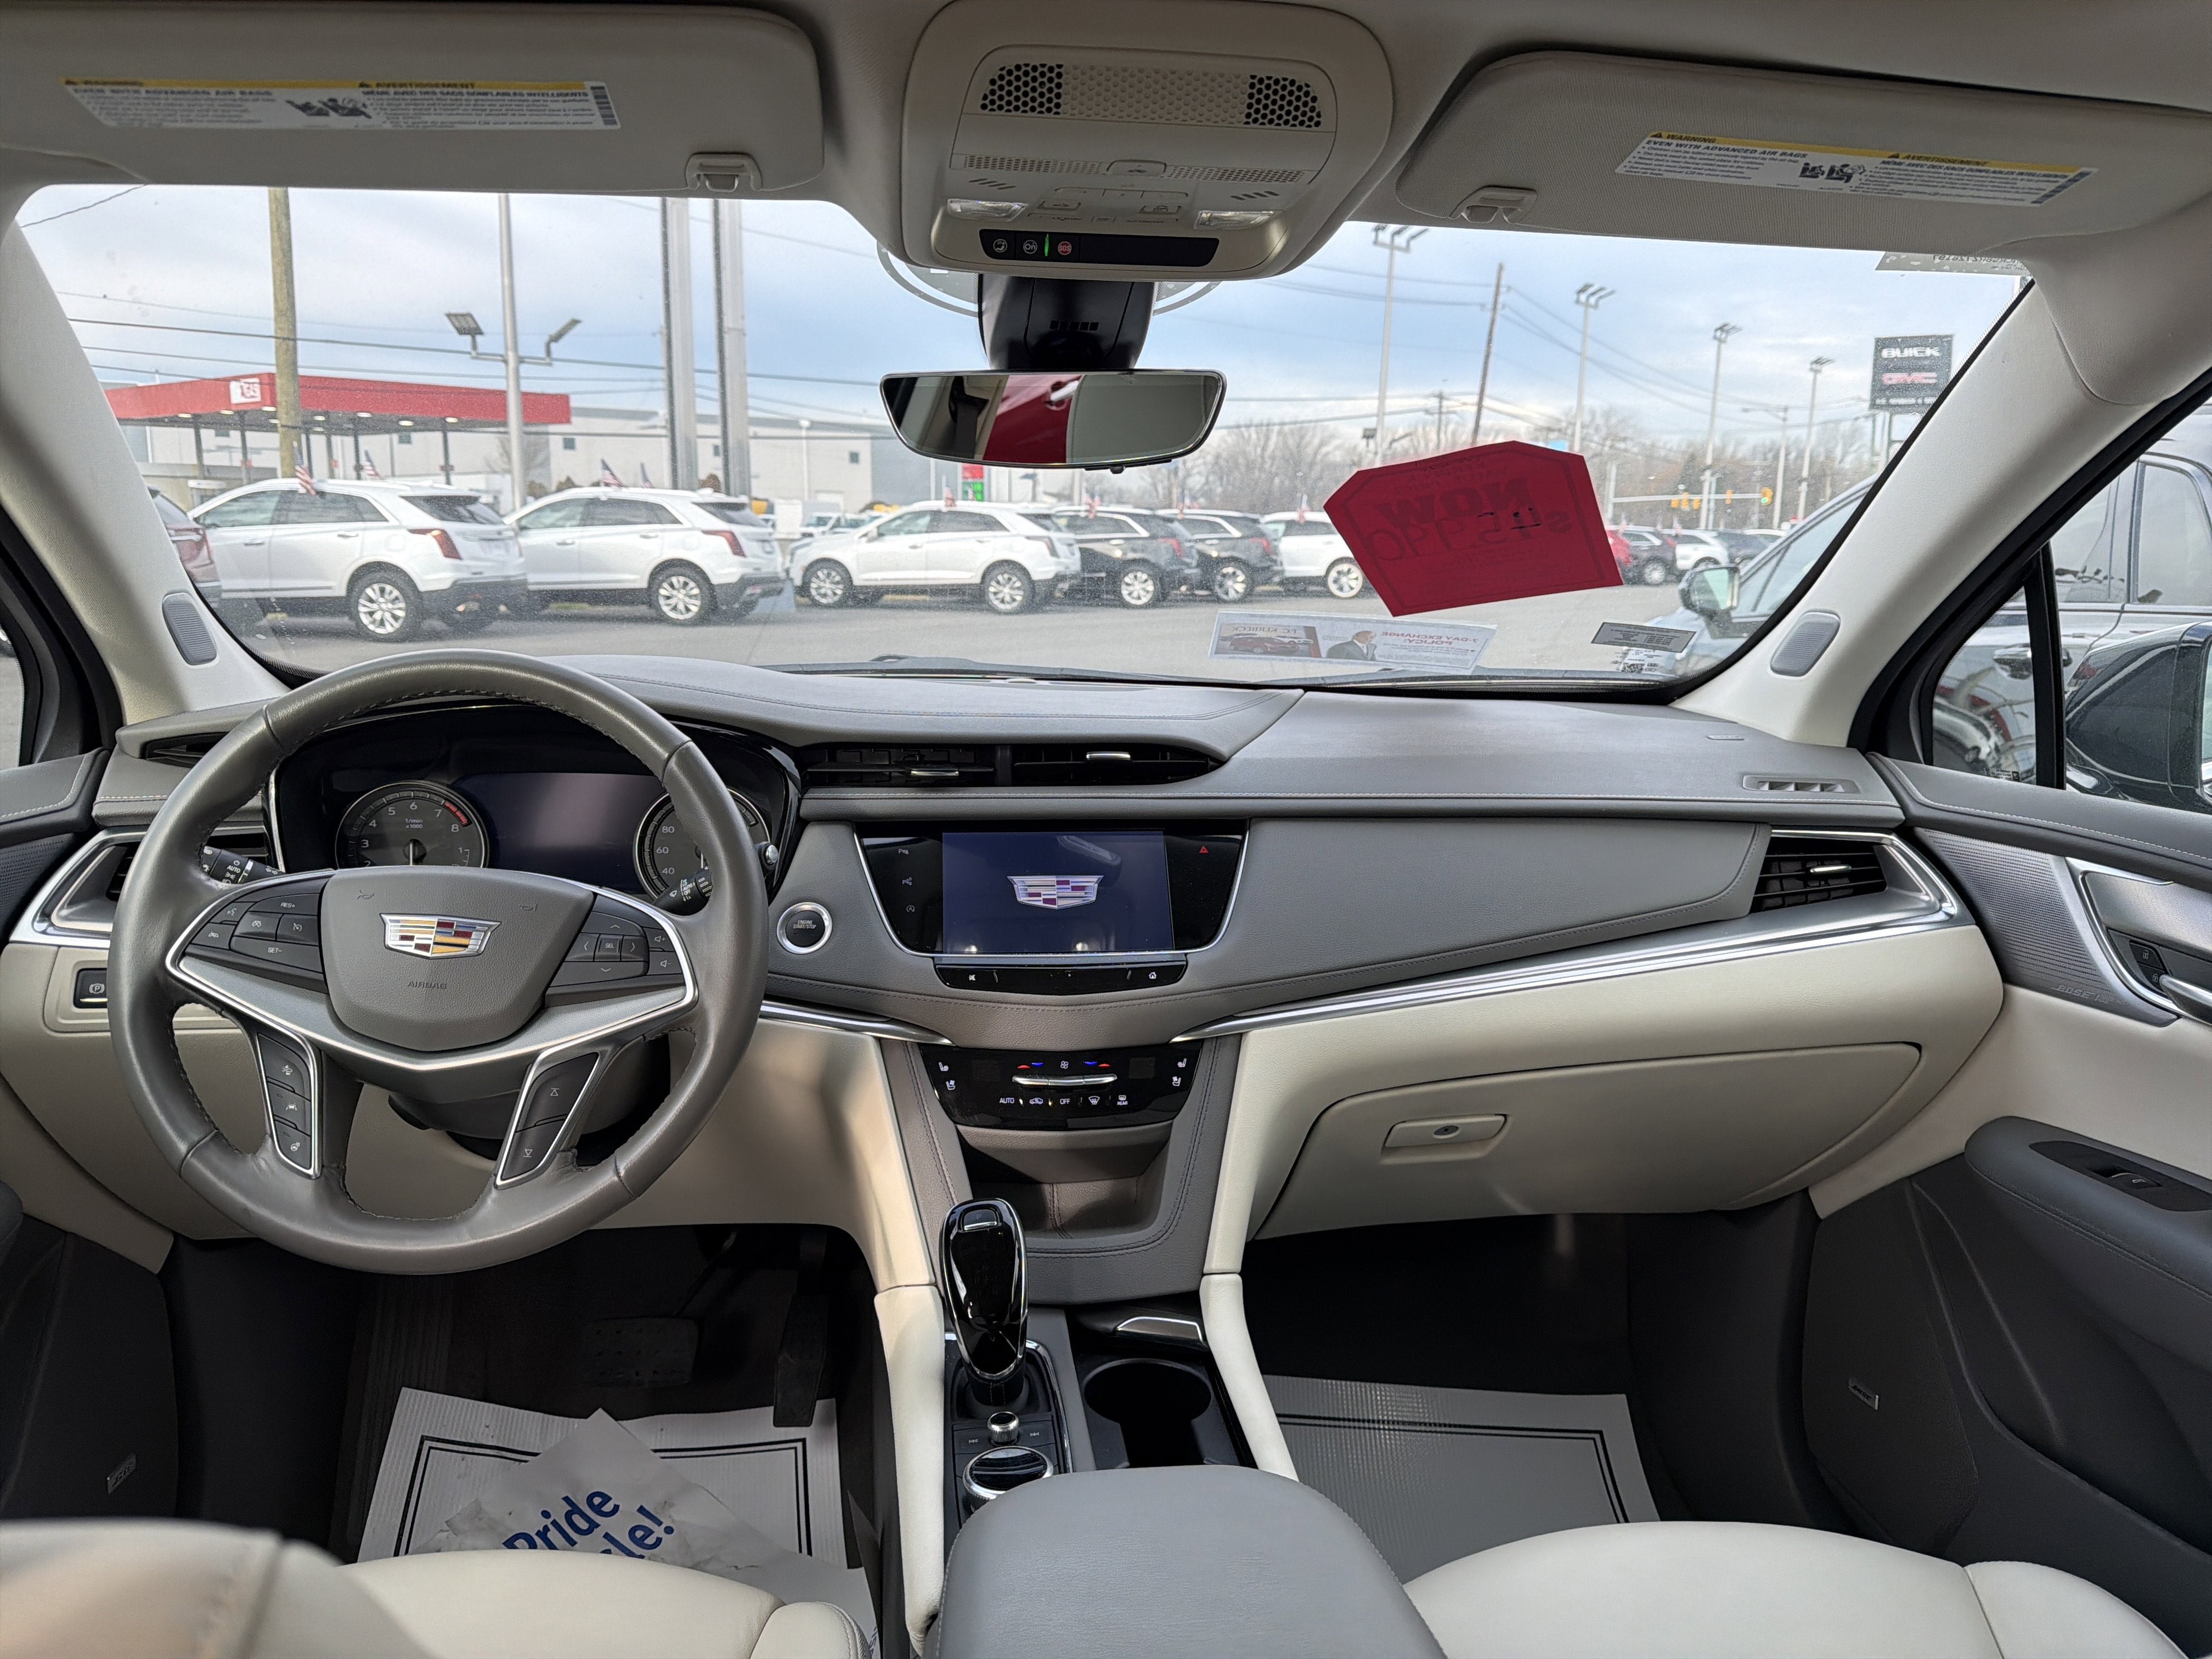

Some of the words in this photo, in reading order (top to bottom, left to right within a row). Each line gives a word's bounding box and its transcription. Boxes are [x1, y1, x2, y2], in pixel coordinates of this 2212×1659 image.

[1666, 133, 1717, 144] WARNING
[1646, 139, 1673, 148] EVEN
[1704, 144, 1757, 154] ADVANCED
[1058, 244, 1071, 252] SOS
[1881, 346, 1940, 358] BUICK
[1882, 372, 1937, 385] GMC
[410, 802, 417, 810] 6
[388, 807, 396, 815] 5
[435, 809, 442, 817] 7
[369, 819, 377, 827] 4
[451, 824, 459, 833] 8
[662, 826, 675, 834] 80
[361, 839, 369, 848] 3
[656, 846, 669, 855] 60
[227, 865, 241, 874] AUTO
[407, 980, 448, 990] AIRBAG
[2050, 984, 2095, 999] BOSE
[501, 1491, 620, 1550] Pride
